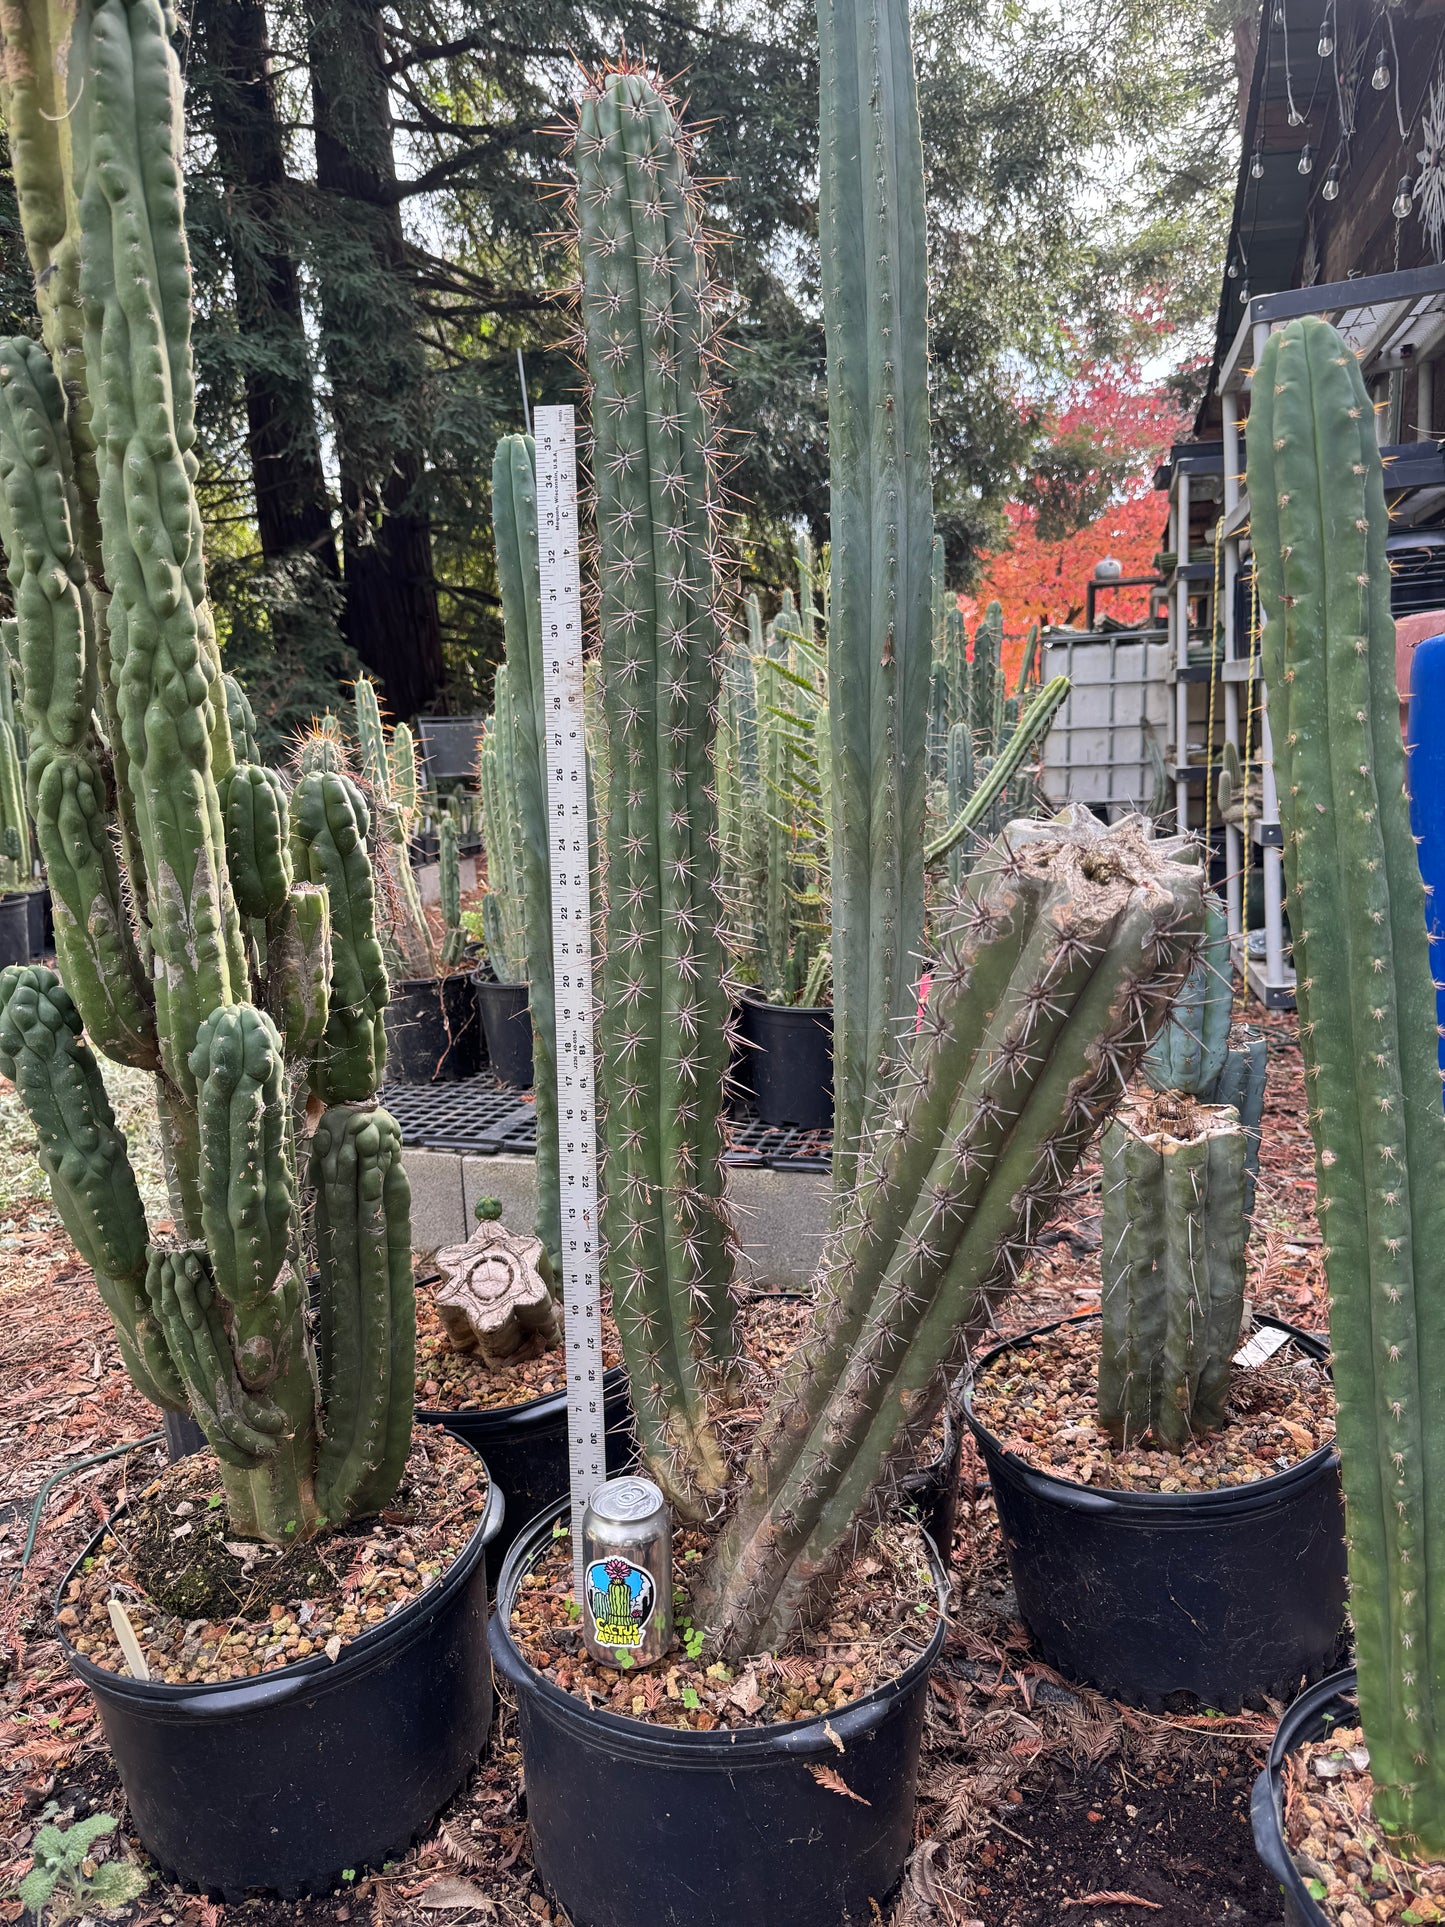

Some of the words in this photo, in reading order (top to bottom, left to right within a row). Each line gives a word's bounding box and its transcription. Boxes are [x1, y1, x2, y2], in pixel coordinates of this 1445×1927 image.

[544, 437, 551, 450] 35
[546, 475, 552, 488] 34
[547, 512, 553, 526] 33
[548, 550, 555, 563] 32
[550, 588, 556, 600] 31
[551, 625, 558, 637] 30
[553, 661, 559, 673] 29
[554, 697, 560, 710] 28
[555, 733, 561, 745] 27
[556, 769, 563, 781] 26
[571, 770, 577, 781] 10
[558, 804, 564, 816] 25
[572, 805, 578, 815] 11
[559, 839, 565, 851] 24
[573, 840, 580, 851] 12
[560, 873, 566, 885] 23
[574, 875, 581, 885] 13
[561, 908, 567, 919] 22
[575, 909, 581, 920] 14
[562, 943, 568, 954] 21
[576, 943, 583, 954] 15
[563, 976, 569, 987] 20
[577, 977, 584, 988] 16
[564, 1009, 570, 1019] 19
[578, 1011, 584, 1021] 17
[565, 1042, 571, 1053] 18
[579, 1045, 585, 1055] 18
[566, 1076, 572, 1086] 17
[580, 1078, 586, 1088] 19
[567, 1110, 573, 1120] 16
[581, 1110, 587, 1121] 20
[567, 1143, 574, 1153] 15
[582, 1143, 588, 1153] 21
[568, 1176, 574, 1185] 14
[582, 1176, 588, 1188] 22
[569, 1209, 575, 1218] 13
[570, 1241, 576, 1250] 12
[584, 1242, 590, 1253] 24
[571, 1275, 578, 1283] 11
[585, 1274, 592, 1285] 25
[572, 1306, 578, 1315] 10
[586, 1306, 592, 1317] 26
[587, 1338, 594, 1349] 27
[588, 1370, 595, 1381] 28
[590, 1402, 596, 1413] 29
[591, 1433, 597, 1444] 30
[592, 1464, 598, 1474] 31
[596, 1618, 638, 1635] CACTUS
[598, 1631, 641, 1645] AFFINITY
